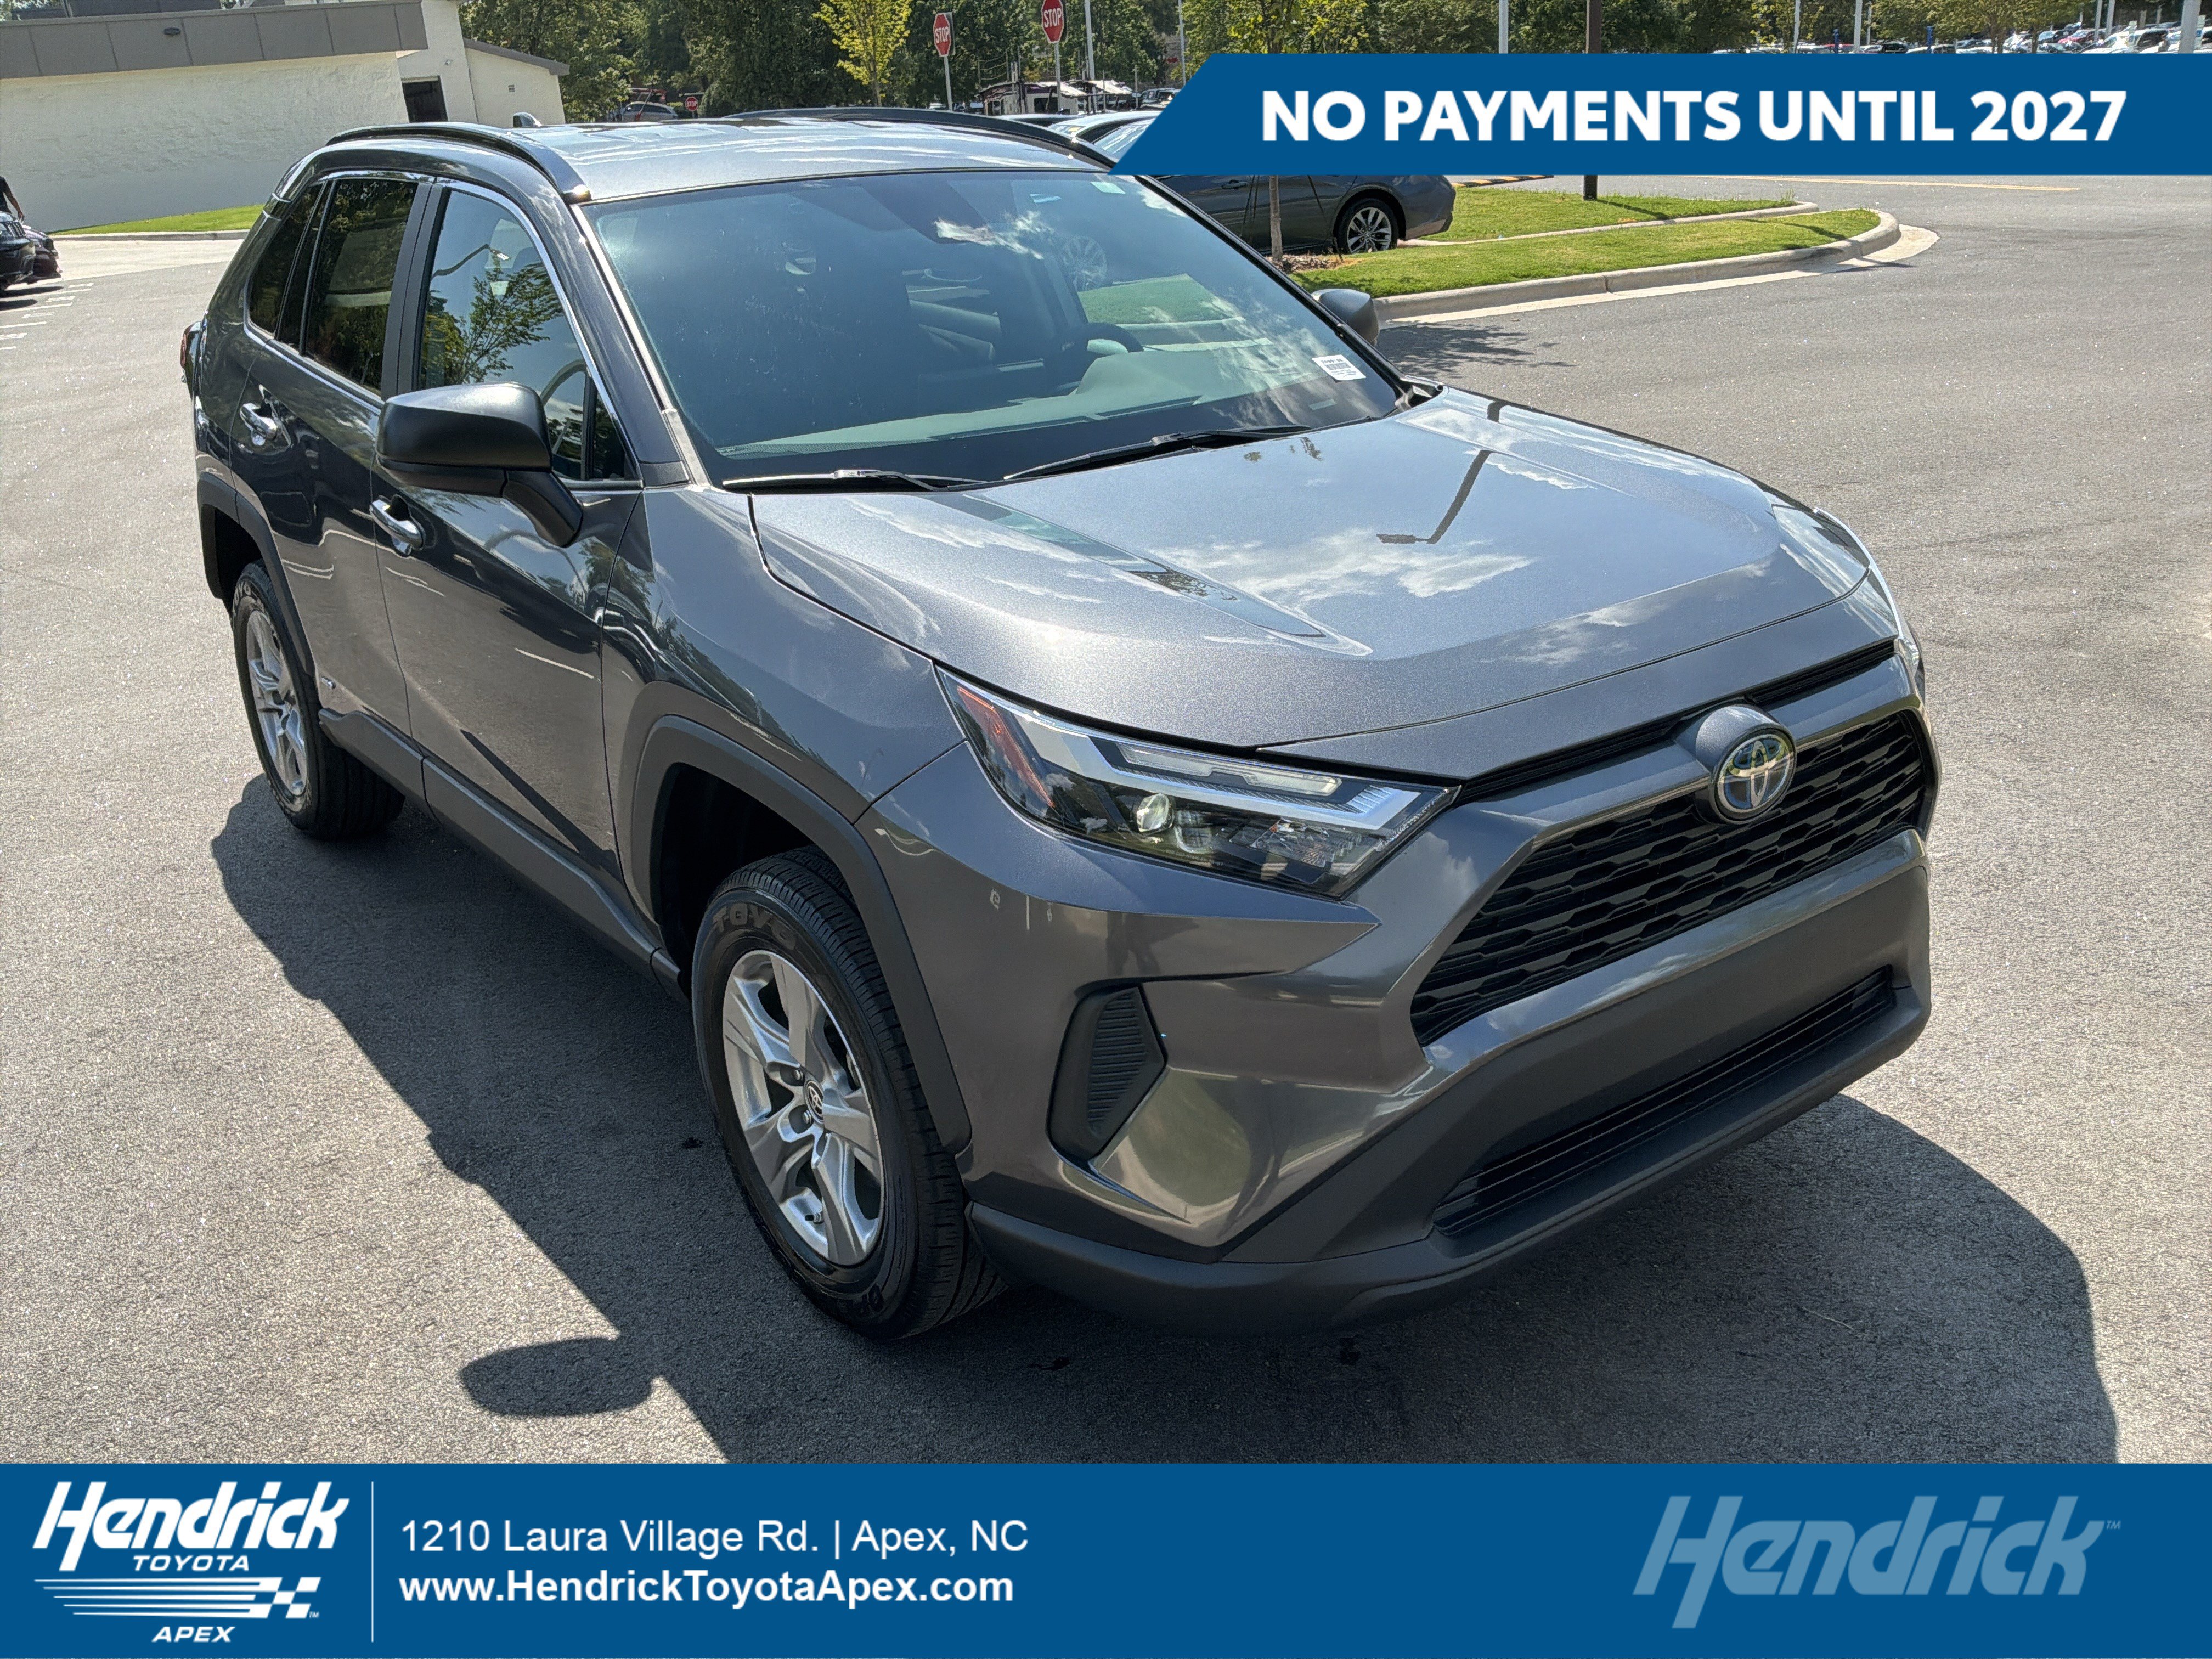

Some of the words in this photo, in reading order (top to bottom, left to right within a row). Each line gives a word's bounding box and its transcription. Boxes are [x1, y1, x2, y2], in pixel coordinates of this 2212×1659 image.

[1044, 8, 1062, 28] STOP
[935, 26, 949, 43] STOP
[713, 902, 796, 950] TOYO
